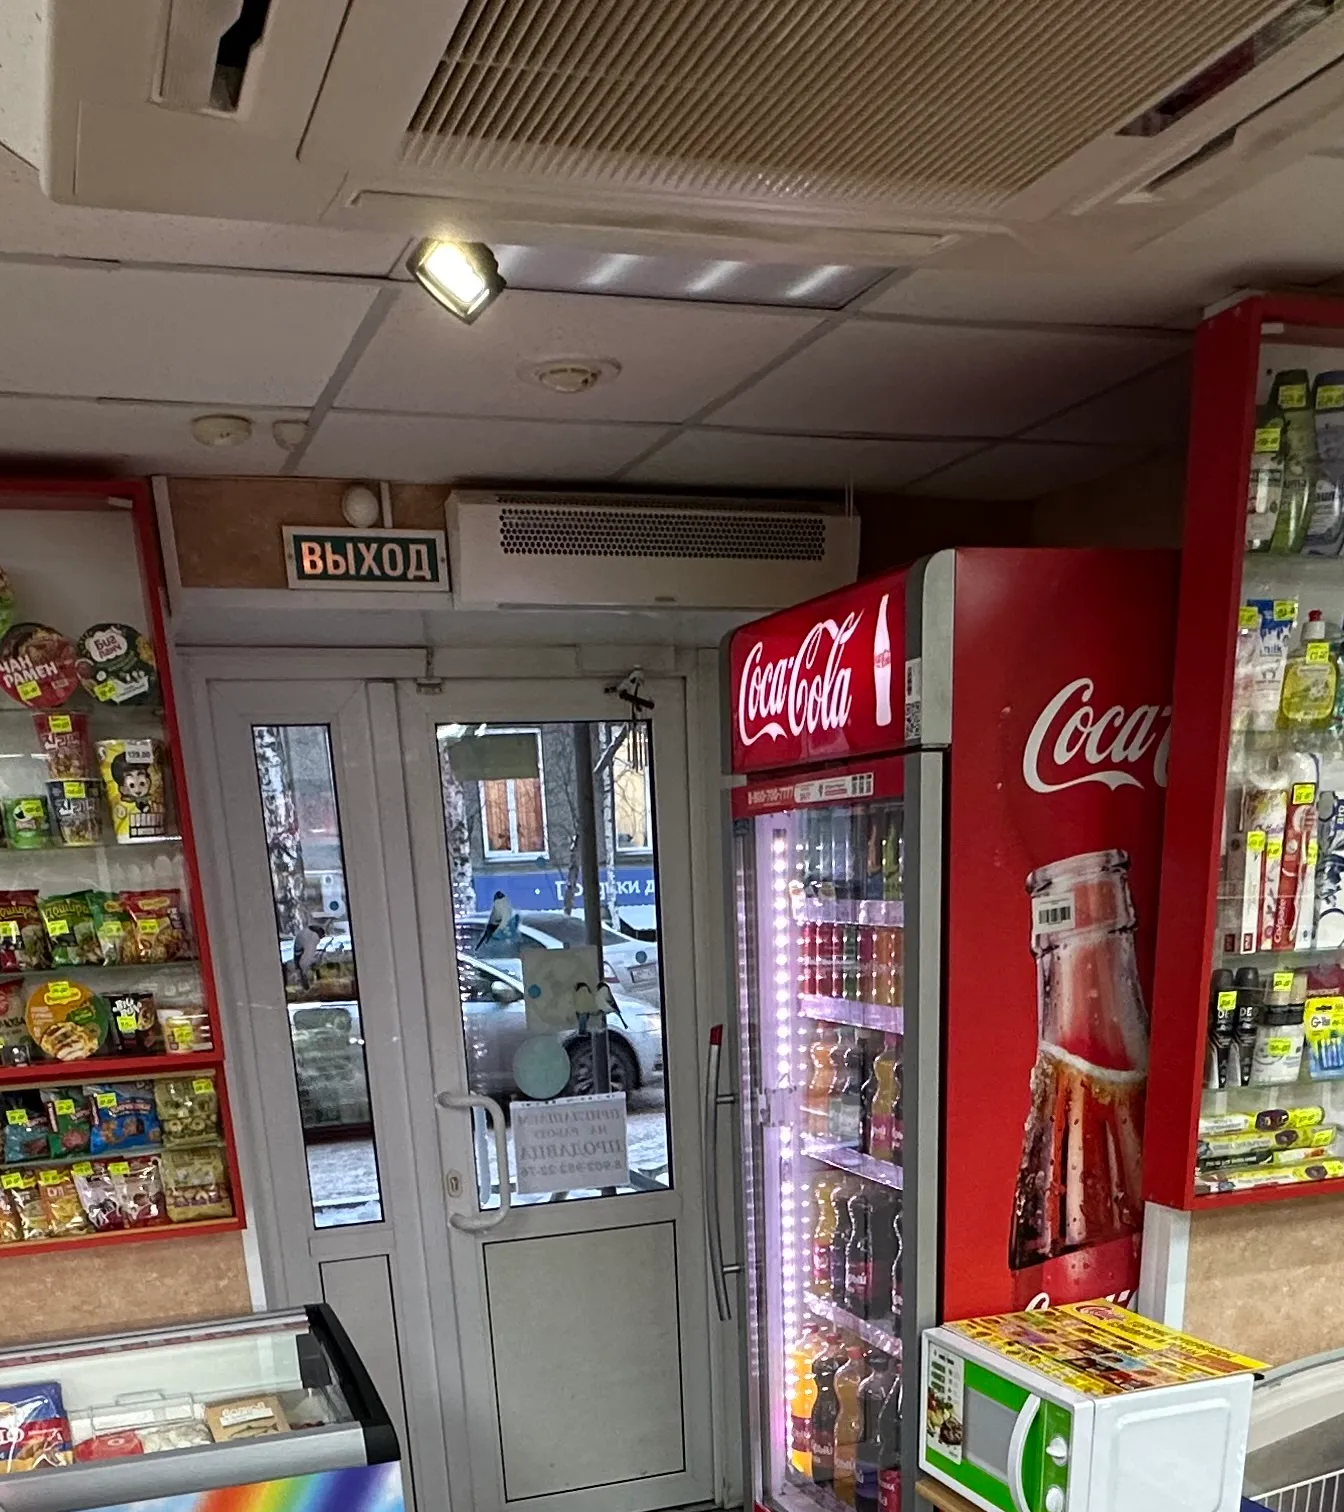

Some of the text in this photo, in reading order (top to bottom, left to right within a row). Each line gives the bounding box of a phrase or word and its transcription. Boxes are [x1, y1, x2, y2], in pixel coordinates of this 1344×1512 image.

[300, 541, 432, 581] ВЫХОД
[739, 607, 865, 746] Coca-Cola
[1023, 677, 1169, 794] Coca-
